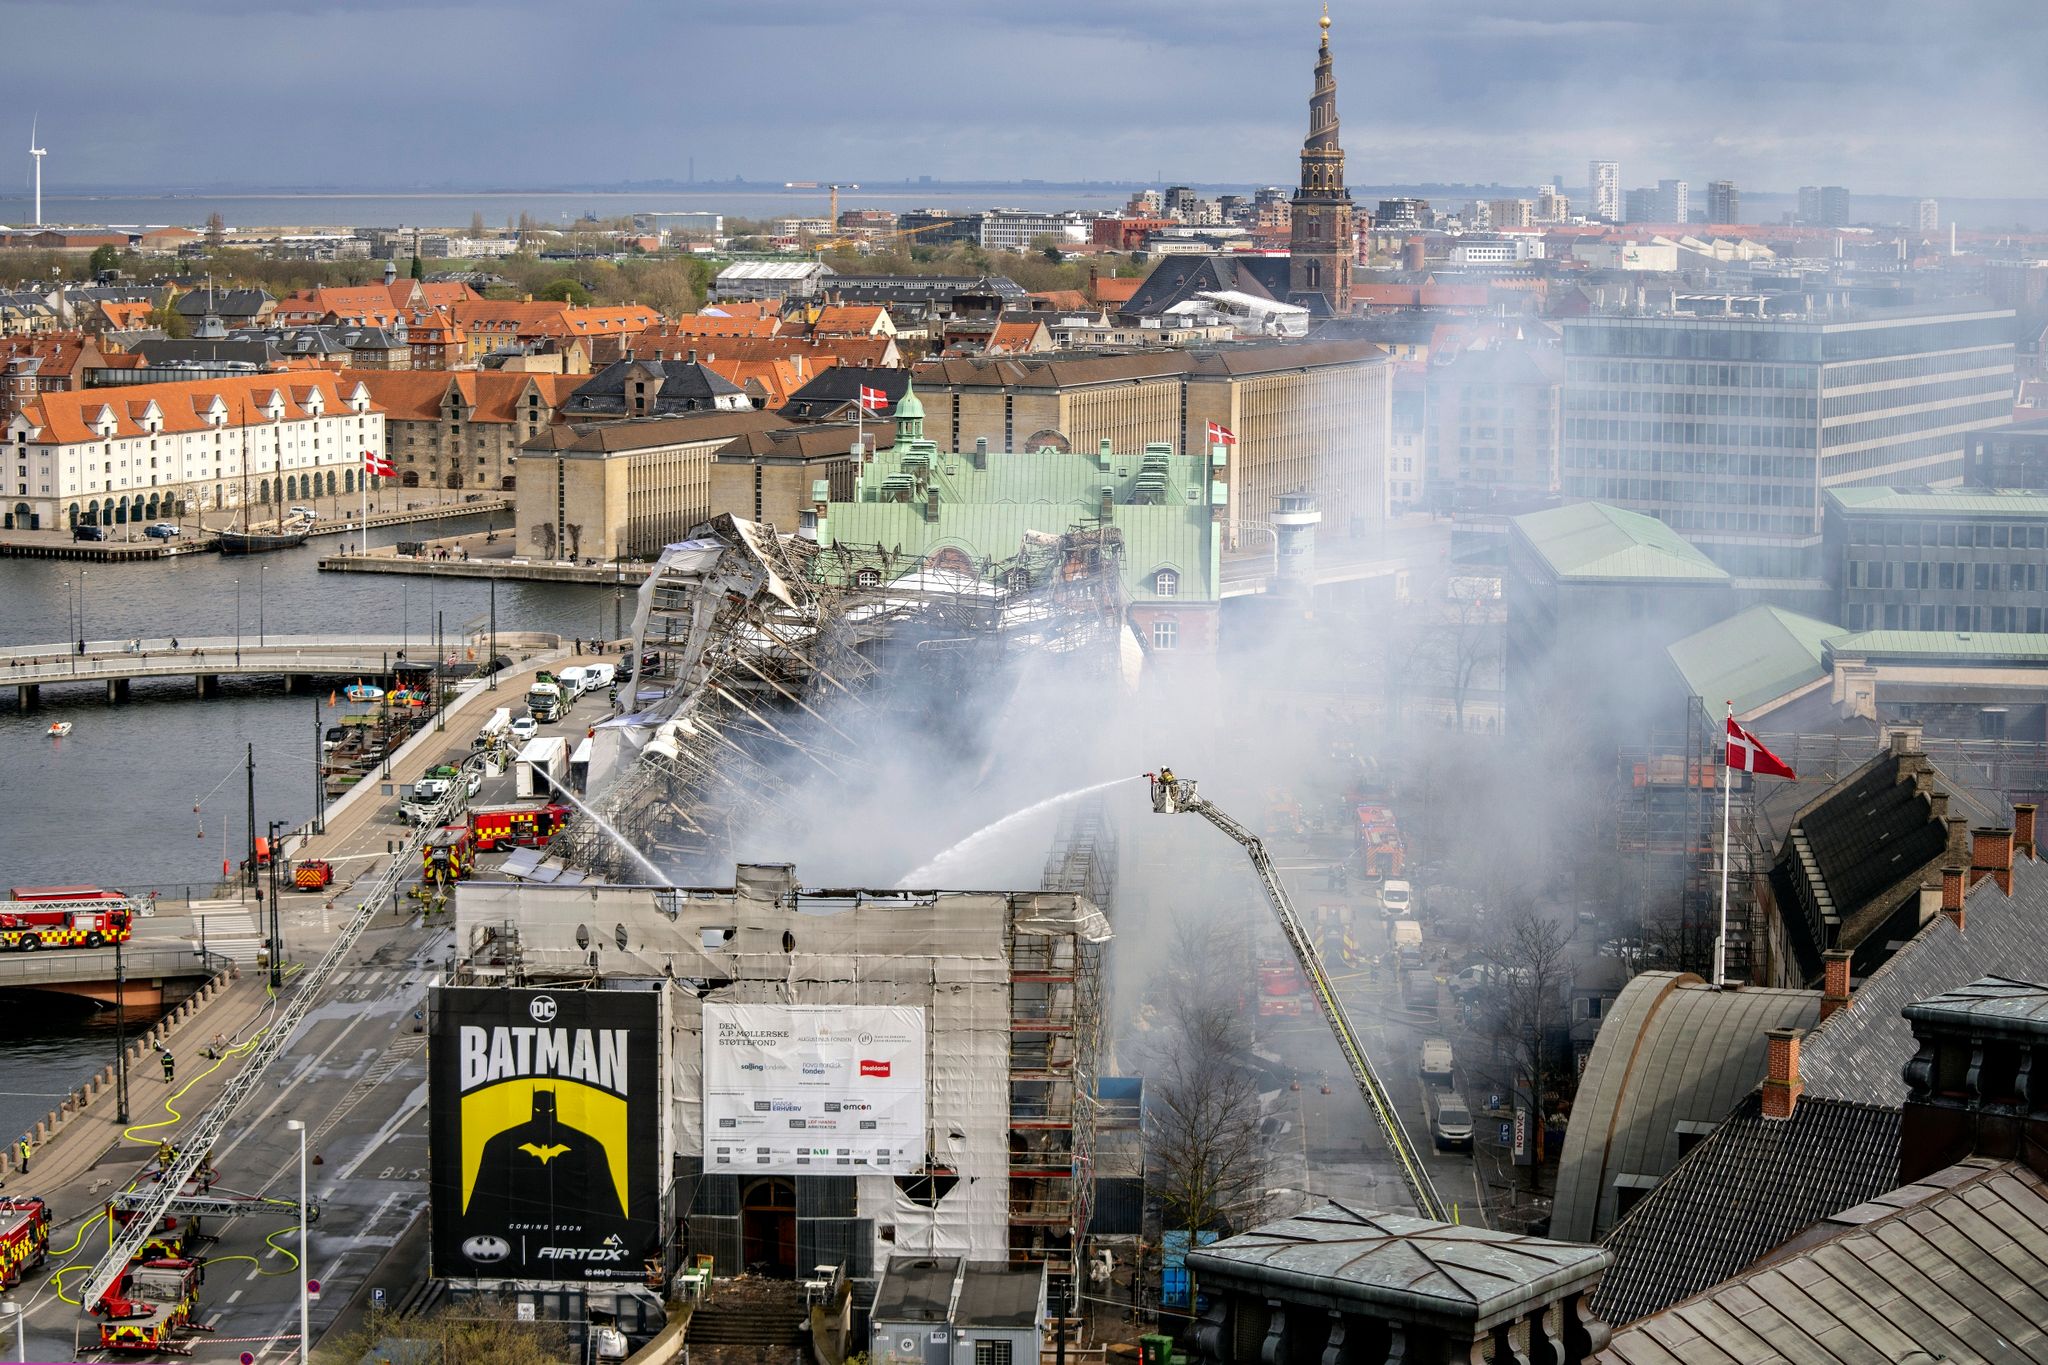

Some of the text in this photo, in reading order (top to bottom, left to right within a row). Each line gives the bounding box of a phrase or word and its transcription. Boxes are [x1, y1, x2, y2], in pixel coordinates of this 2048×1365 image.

[335, 989, 372, 999] BUS
[531, 1000, 555, 1018] DC
[736, 1030, 790, 1038] MØLLERSKE
[719, 1039, 776, 1047] STØTTEFOND
[460, 1025, 628, 1097] BATMAN
[741, 1063, 764, 1072] salling
[1491, 1095, 1498, 1104] P
[1502, 1124, 1509, 1132] P
[1516, 1115, 1525, 1148] JAKON
[378, 1166, 426, 1180] BUS
[509, 1223, 549, 1231] COMING
[376, 1290, 383, 1299] P
